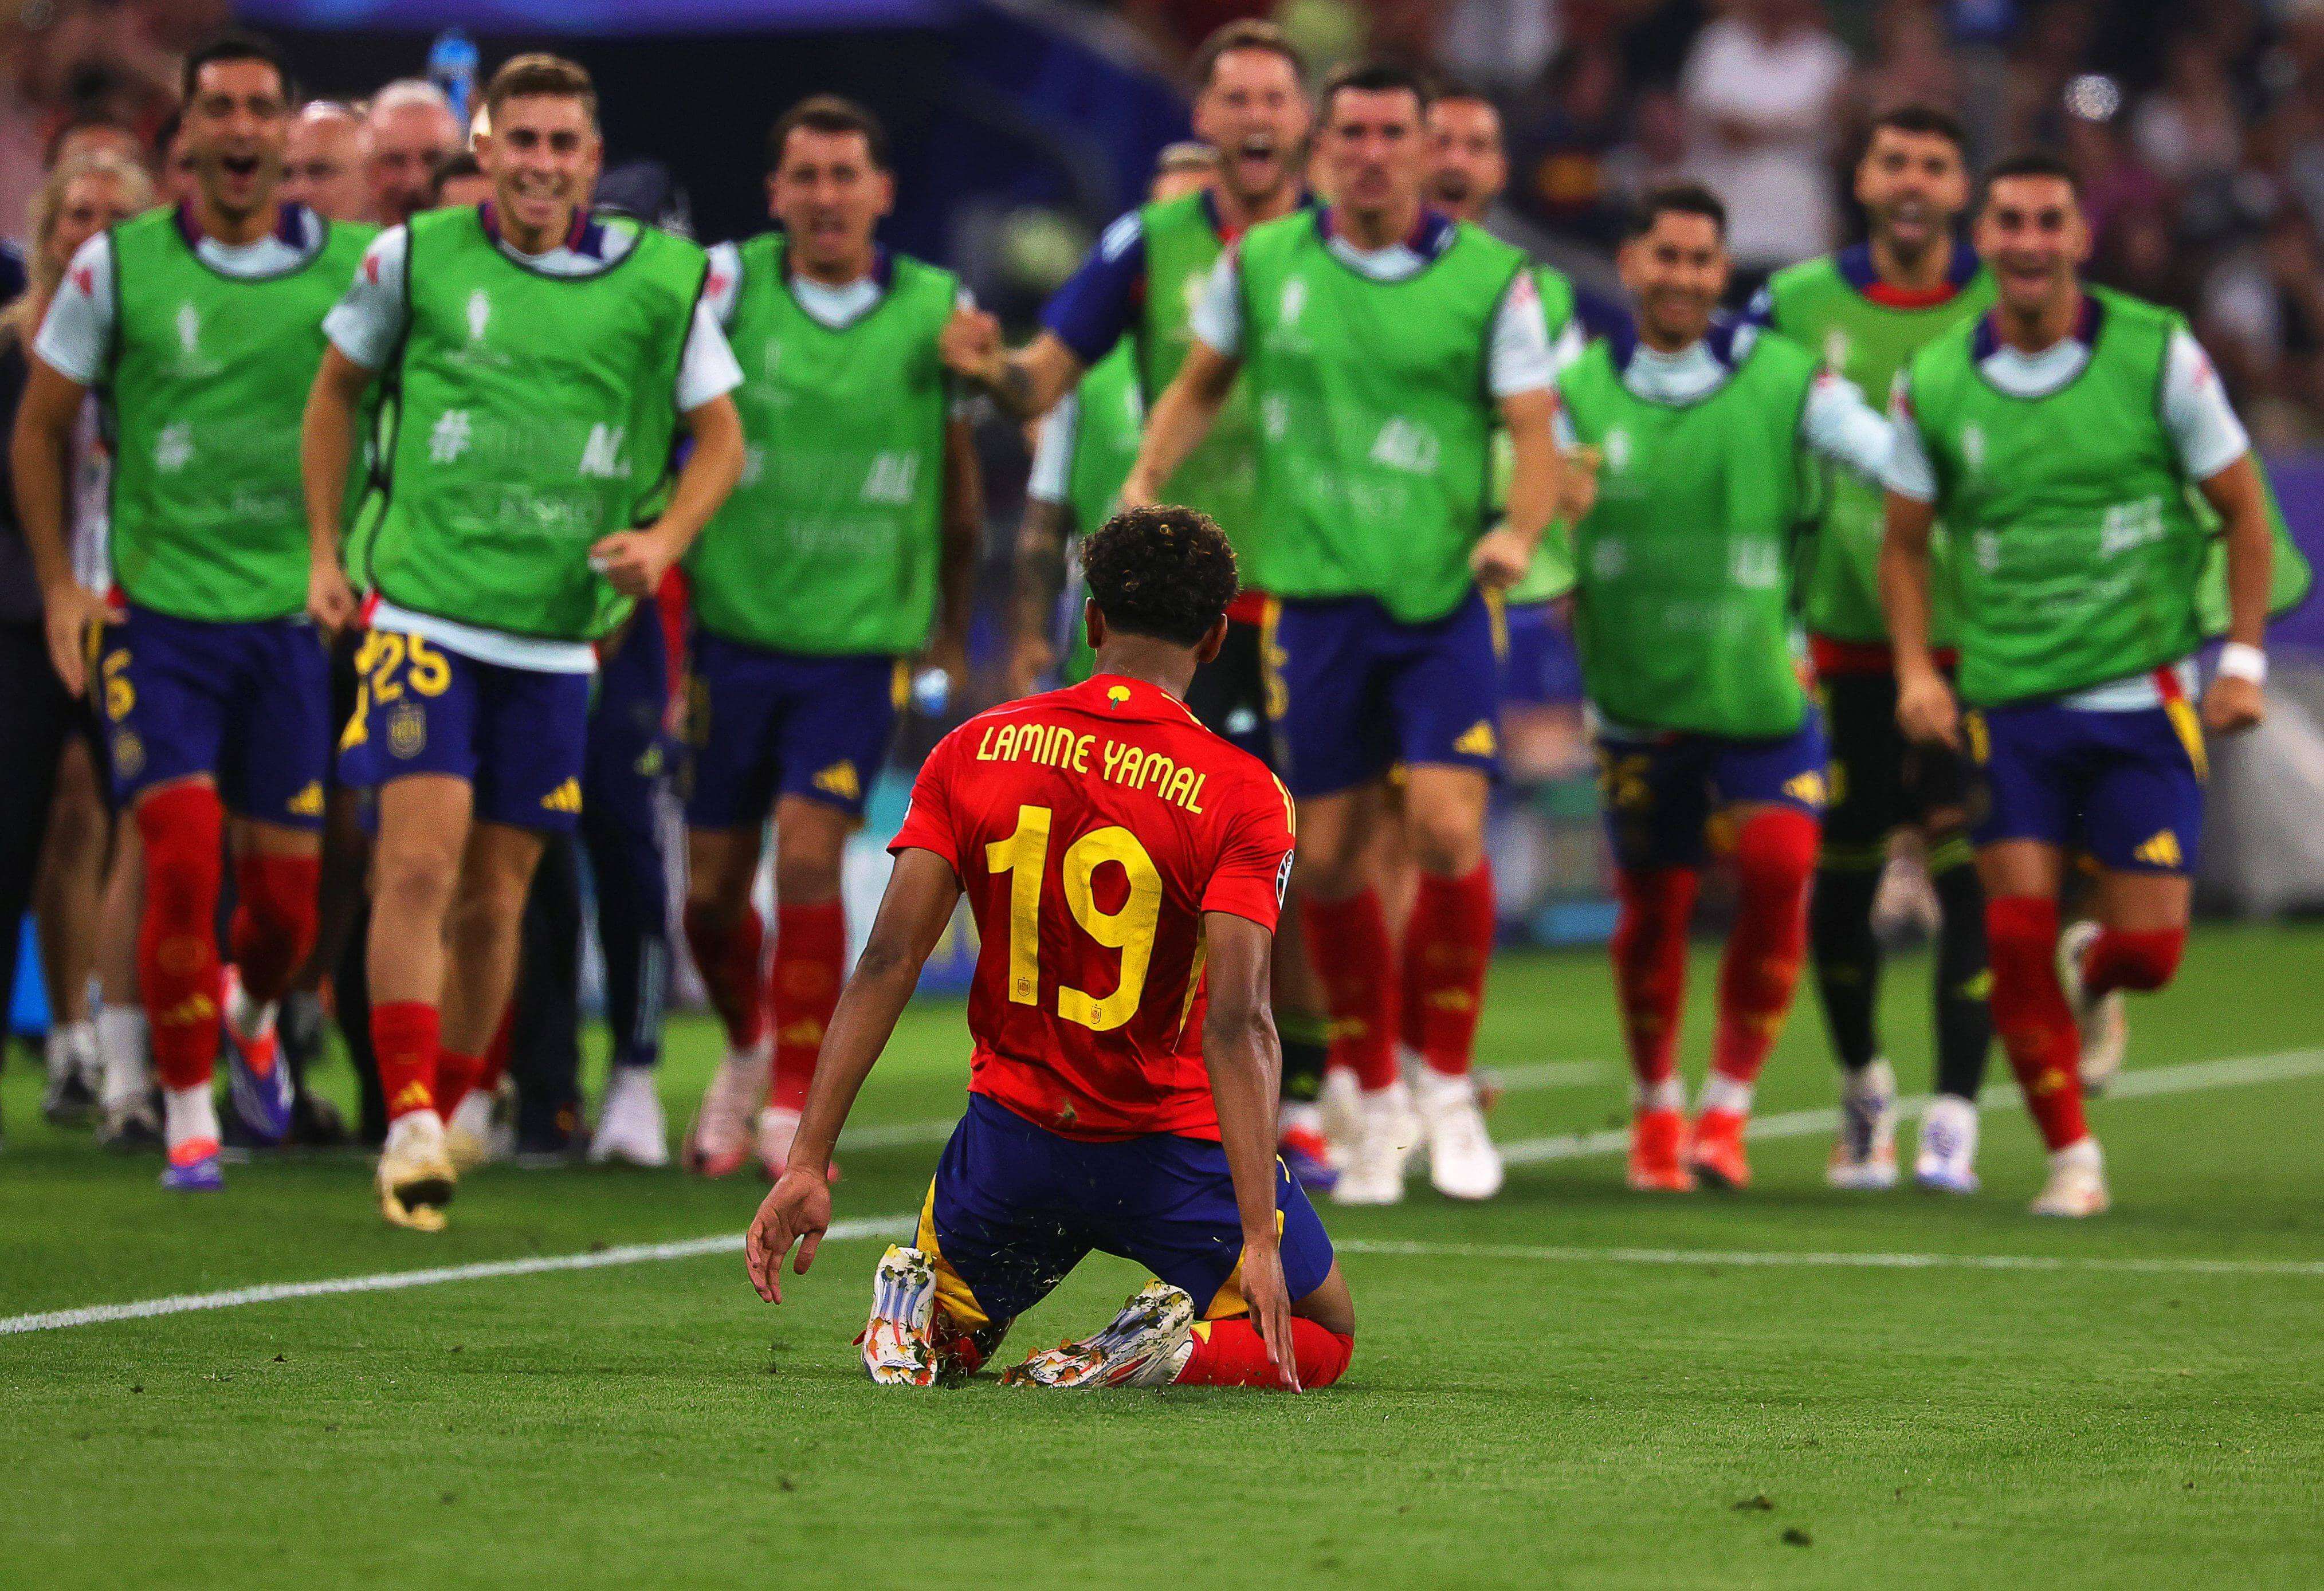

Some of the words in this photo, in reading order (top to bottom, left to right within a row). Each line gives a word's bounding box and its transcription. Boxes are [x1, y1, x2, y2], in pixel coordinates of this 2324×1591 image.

[371, 630, 452, 706] 25
[976, 724, 1096, 773] LAMINE
[1104, 740, 1206, 814] YAMAL
[985, 804, 1163, 1031] 19
